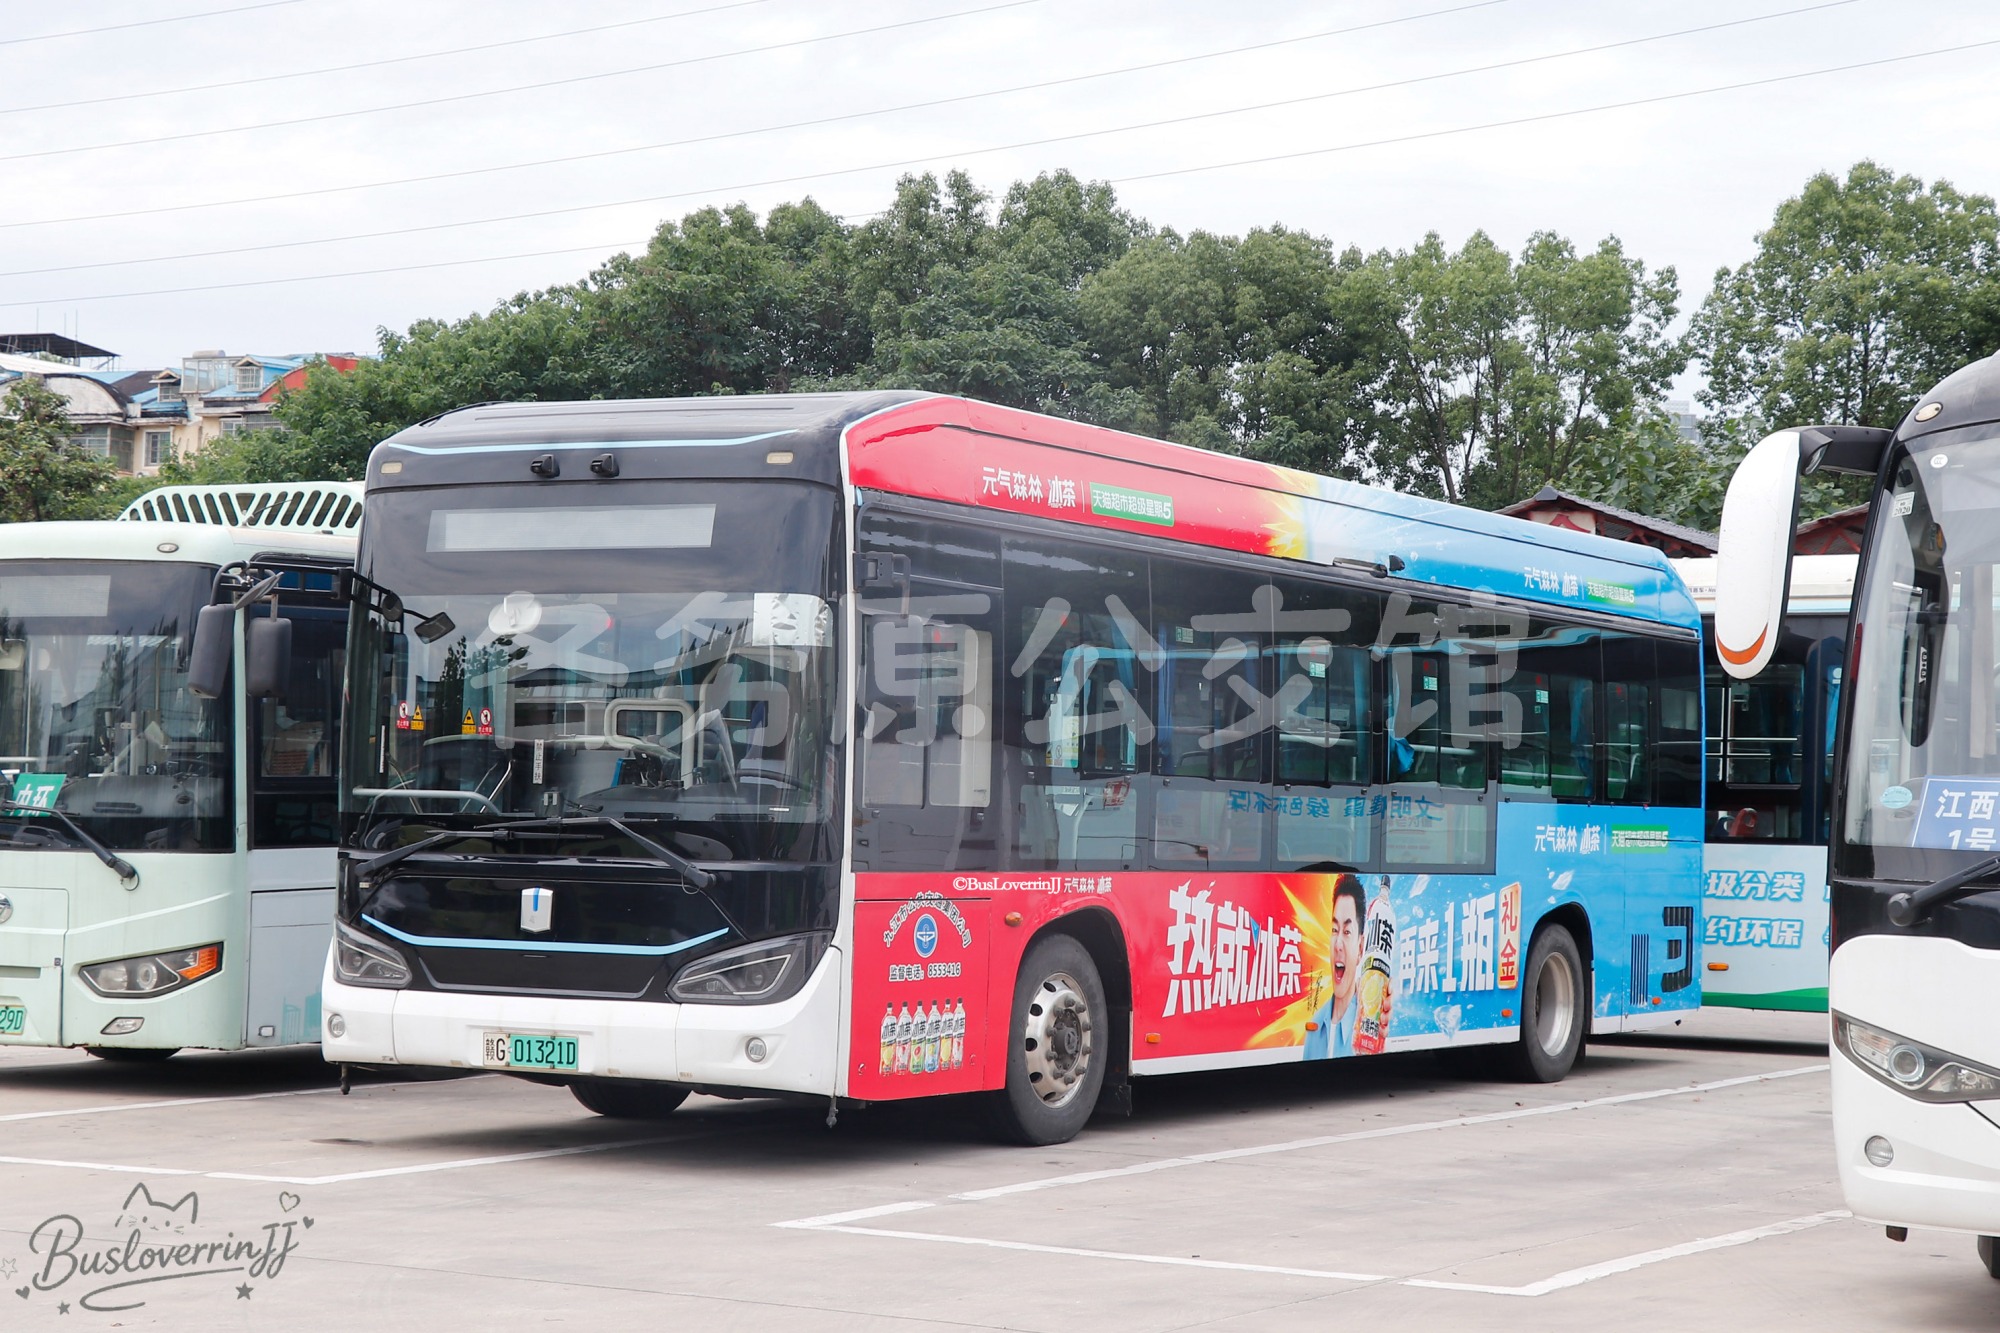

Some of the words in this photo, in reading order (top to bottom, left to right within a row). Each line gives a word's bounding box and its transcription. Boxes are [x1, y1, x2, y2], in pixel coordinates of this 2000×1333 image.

[983, 466, 1043, 503] 元气森林
[1048, 475, 1076, 508] 冰茶
[1093, 489, 1171, 519] 天猫超市超级星期5
[1524, 566, 1559, 594] 元气森林
[1935, 788, 2000, 820] 江西
[1535, 824, 1577, 852] 元气森林
[1948, 828, 1997, 851] 1号
[1064, 876, 1095, 893] 元气森林
[1702, 870, 1804, 901] 圾分类
[1400, 893, 1496, 994] 再来1瓶
[1500, 892, 1518, 982] 礼金
[1703, 916, 1804, 948] 约环保
[1162, 879, 1302, 1018] 热就冰茶
[928, 962, 960, 978] 8553416
[514, 1039, 576, 1065] 01321D
